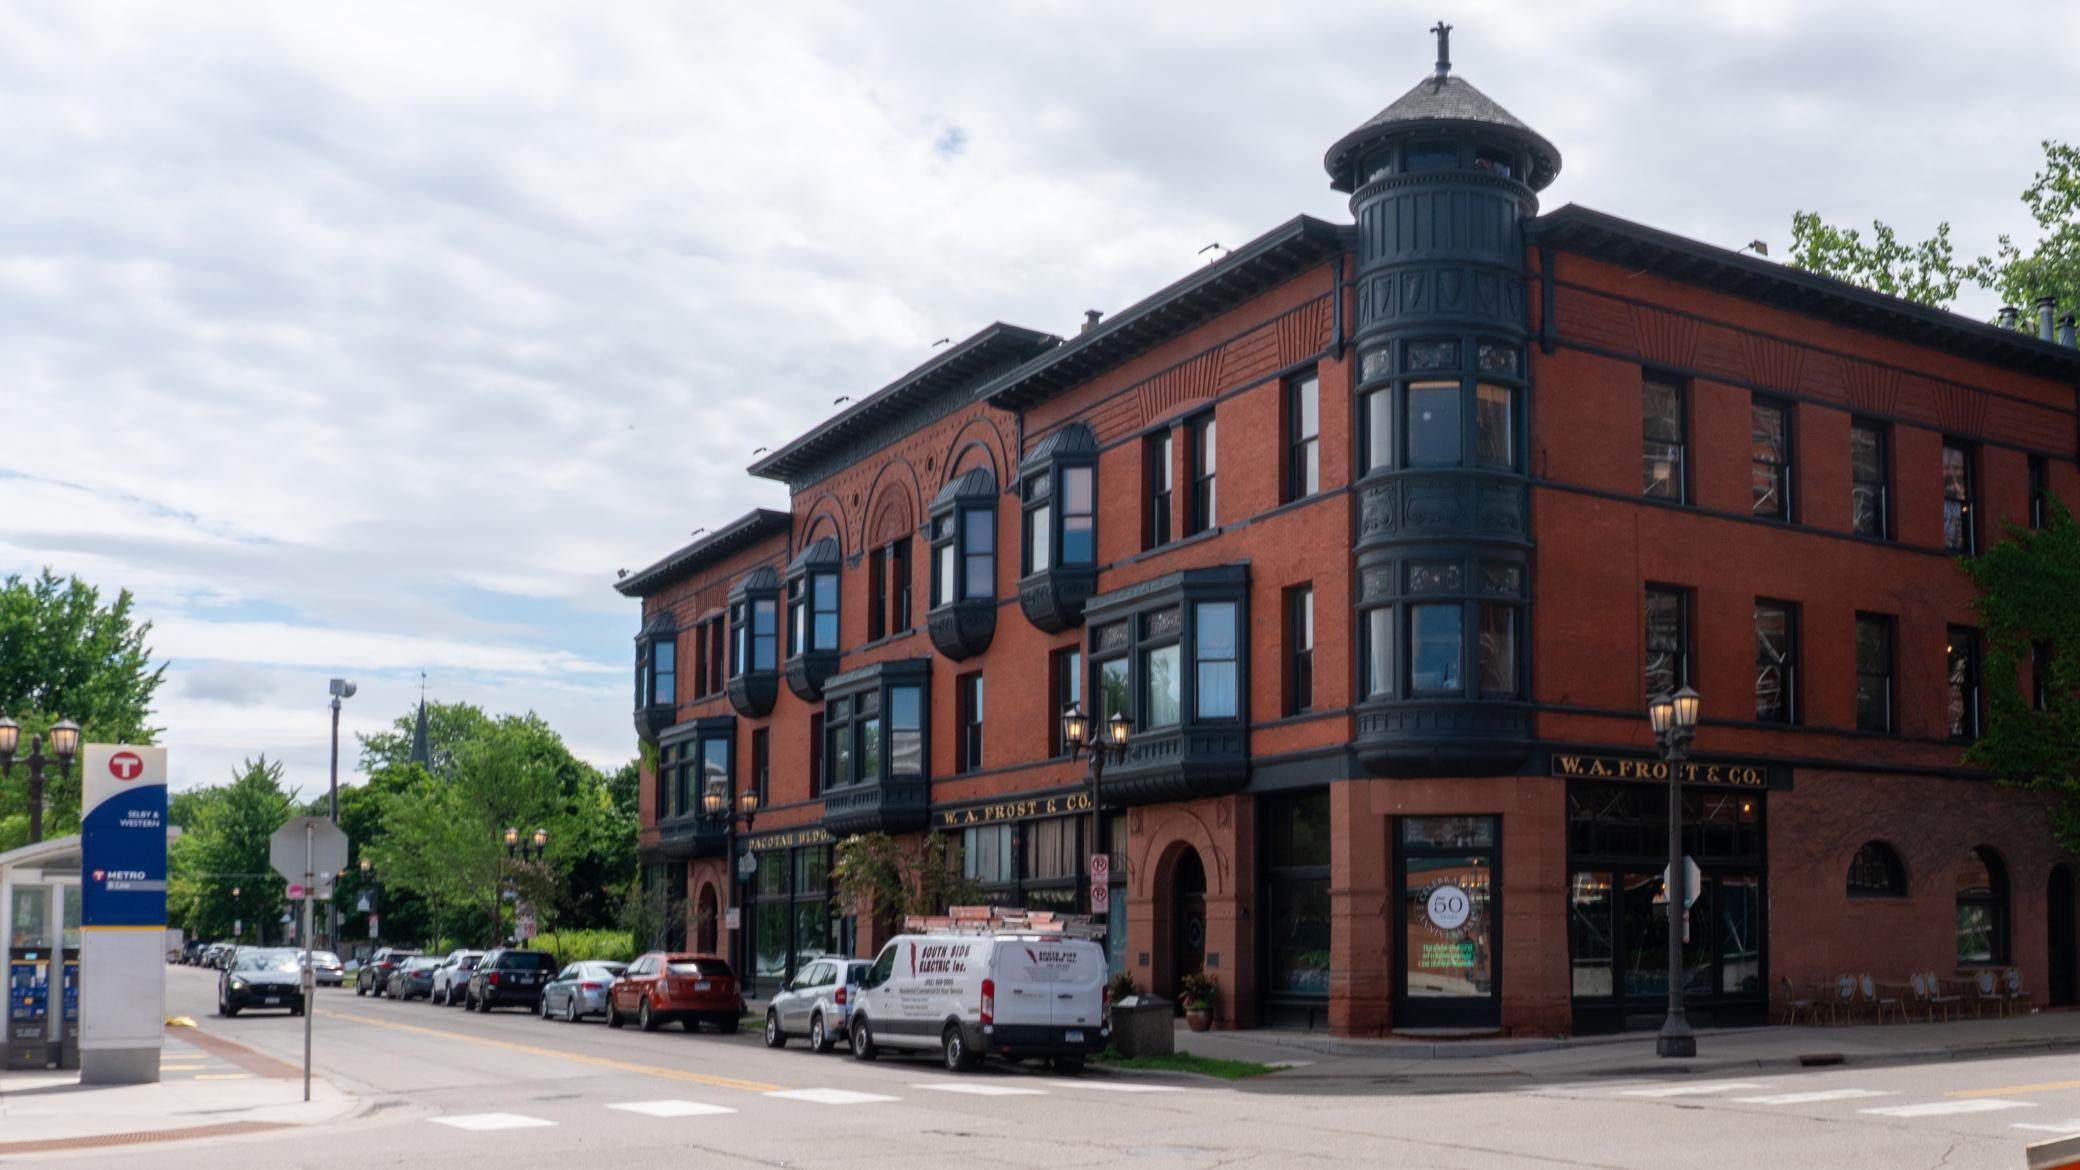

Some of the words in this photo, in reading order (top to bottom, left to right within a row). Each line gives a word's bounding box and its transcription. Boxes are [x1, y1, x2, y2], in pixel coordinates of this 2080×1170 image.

[1560, 756, 1584, 774] W.
[1589, 758, 1612, 776] A.
[1619, 759, 1699, 781] FROT
[1706, 765, 1720, 782] &
[1728, 768, 1761, 785] CO.
[127, 810, 151, 818] SELBY
[943, 810, 958, 825] W.
[964, 808, 978, 824] A.
[985, 799, 1037, 820] FROST
[1046, 798, 1056, 814] &
[1066, 793, 1091, 811] CO.
[119, 819, 160, 828] WESTERN
[107, 870, 146, 880] METRO
[1434, 895, 1463, 913] 50
[922, 945, 948, 959] SOUTH
[950, 944, 971, 957] SIDE
[919, 959, 951, 973] ELECTRIC
